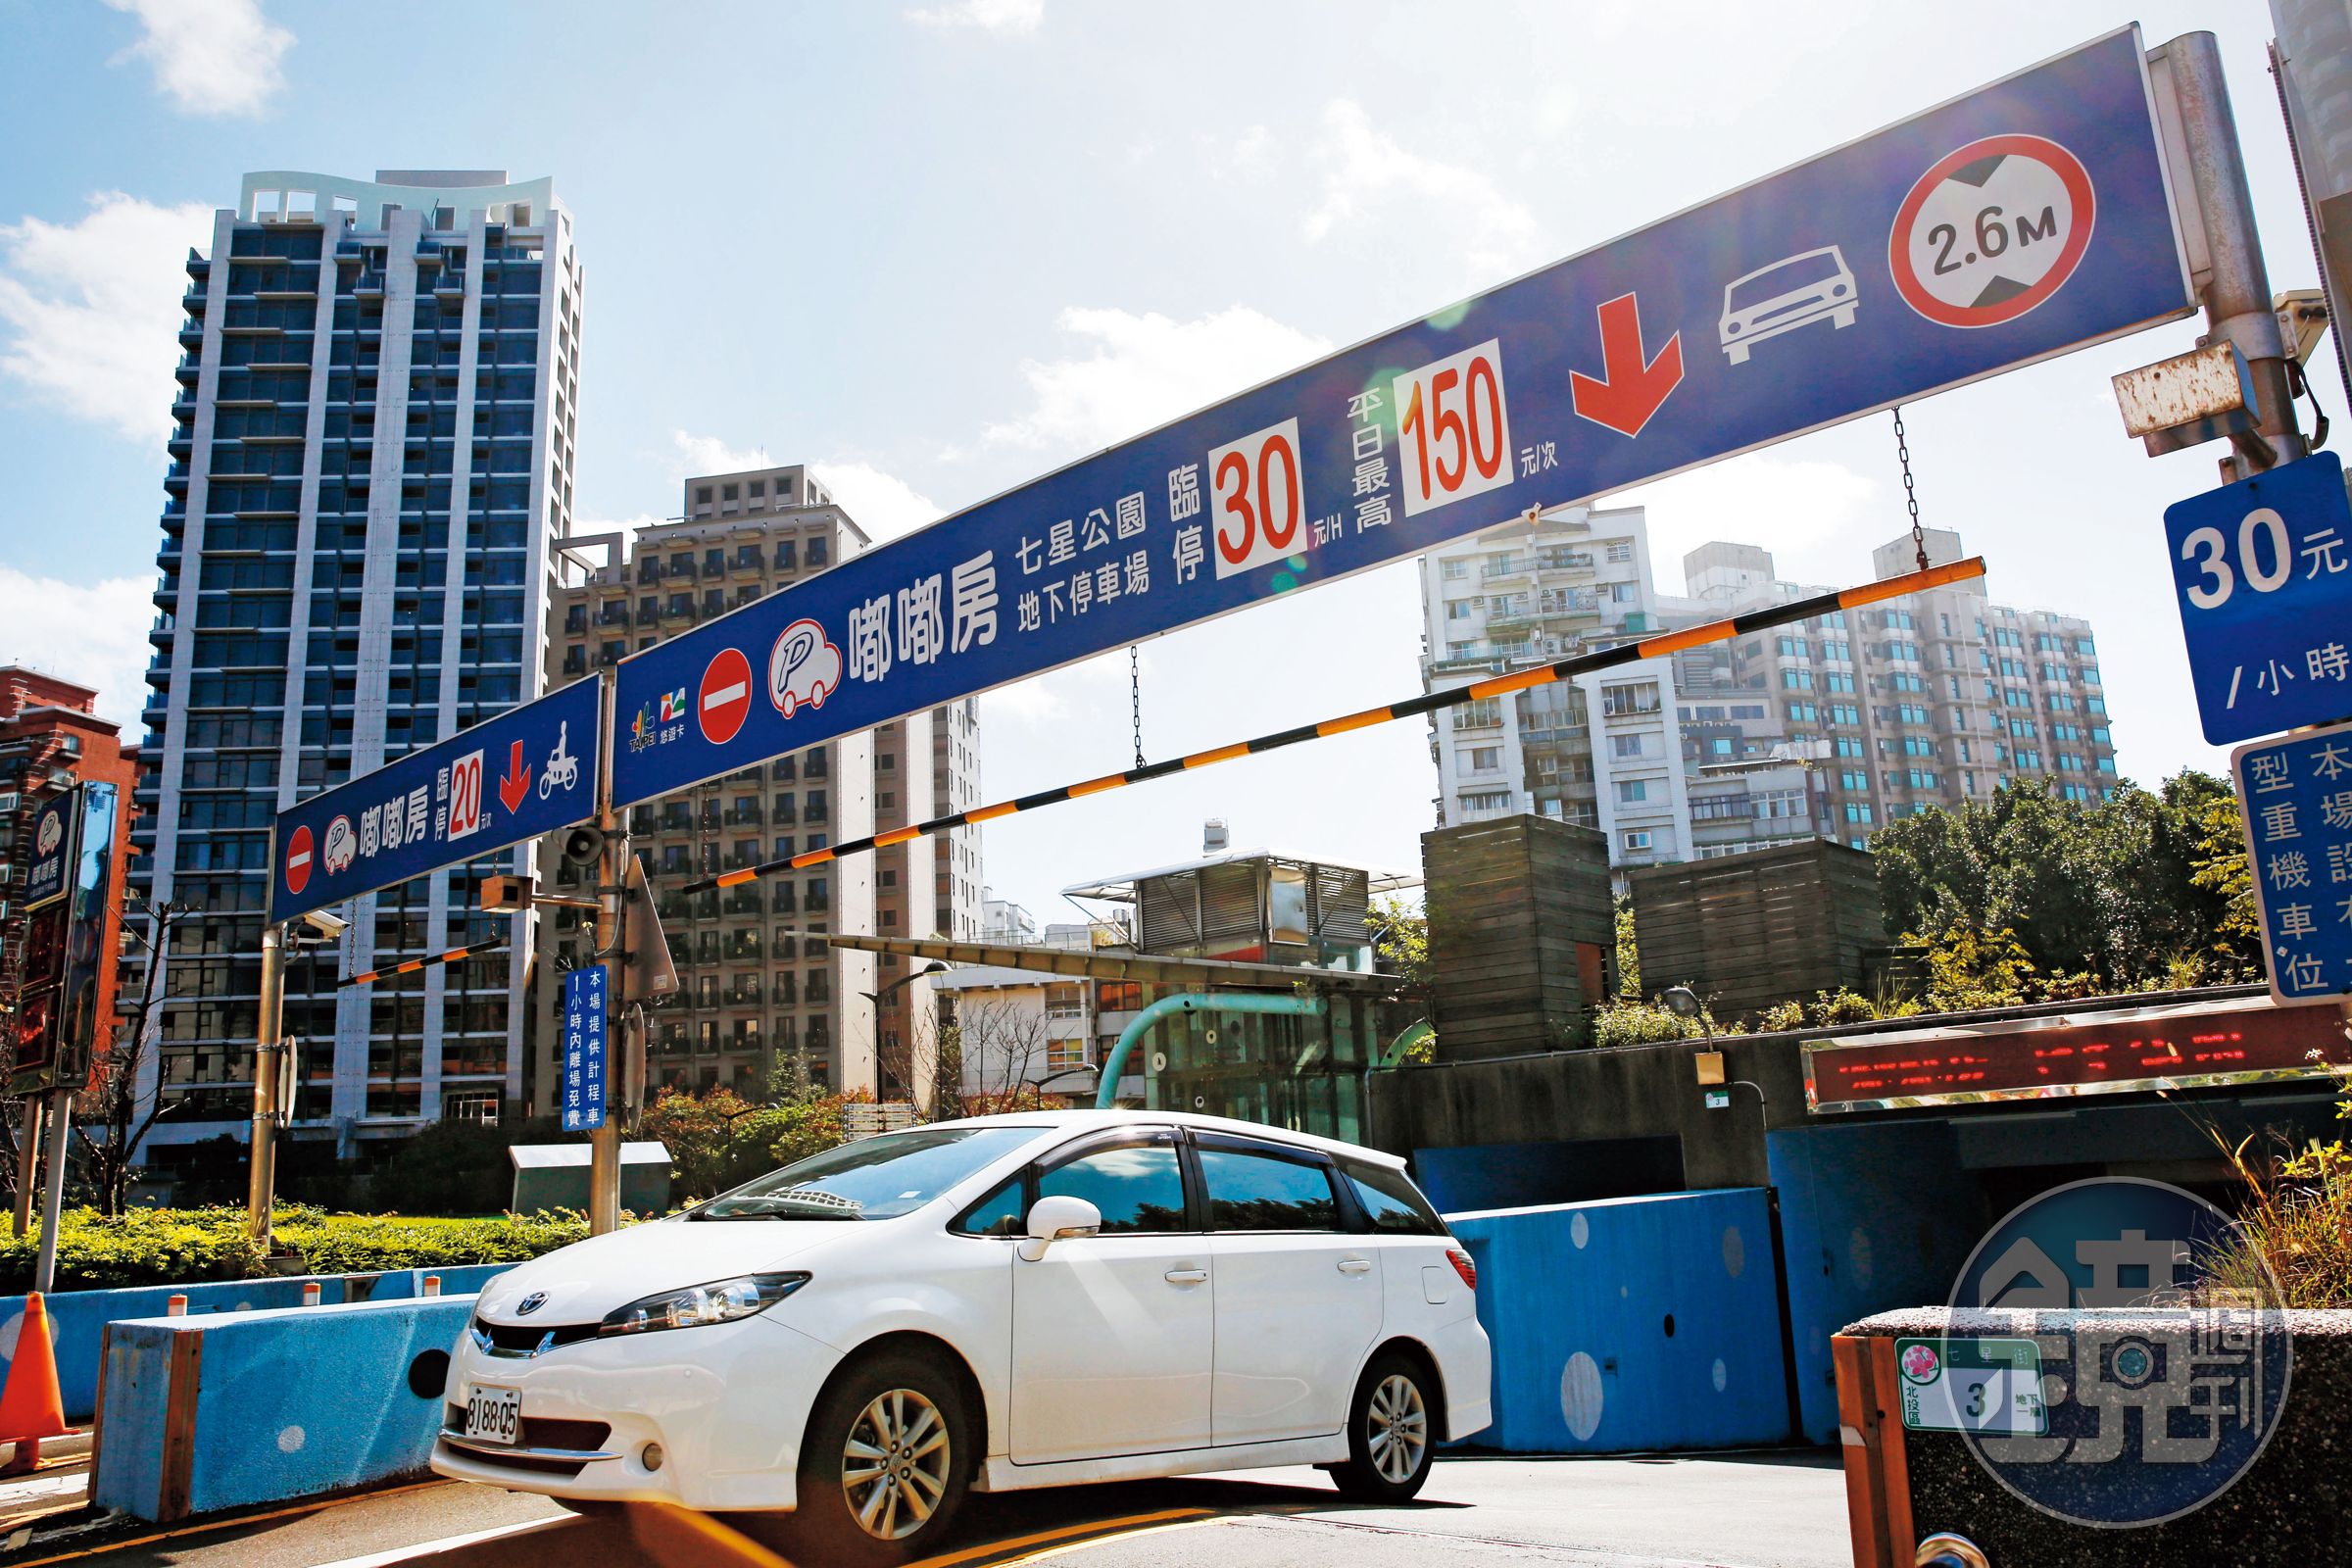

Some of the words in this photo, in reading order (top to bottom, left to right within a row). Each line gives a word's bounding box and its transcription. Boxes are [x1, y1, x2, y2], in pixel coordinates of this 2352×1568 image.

[1348, 387, 1393, 534] 平日最高
[1401, 356, 1503, 501] 150
[1015, 491, 1146, 576] 七星公園
[1167, 463, 1205, 586] 臨停
[1215, 434, 1299, 564] 30
[849, 550, 999, 683] 嘟嘟房
[1017, 549, 1150, 633] 地下停車場
[359, 784, 428, 858] 嘟嘟房
[450, 758, 481, 834] 20
[2251, 752, 2329, 993] 型重機車位
[587, 970, 602, 1126] 本場提供計程車
[1966, 1383, 1986, 1417] 3
